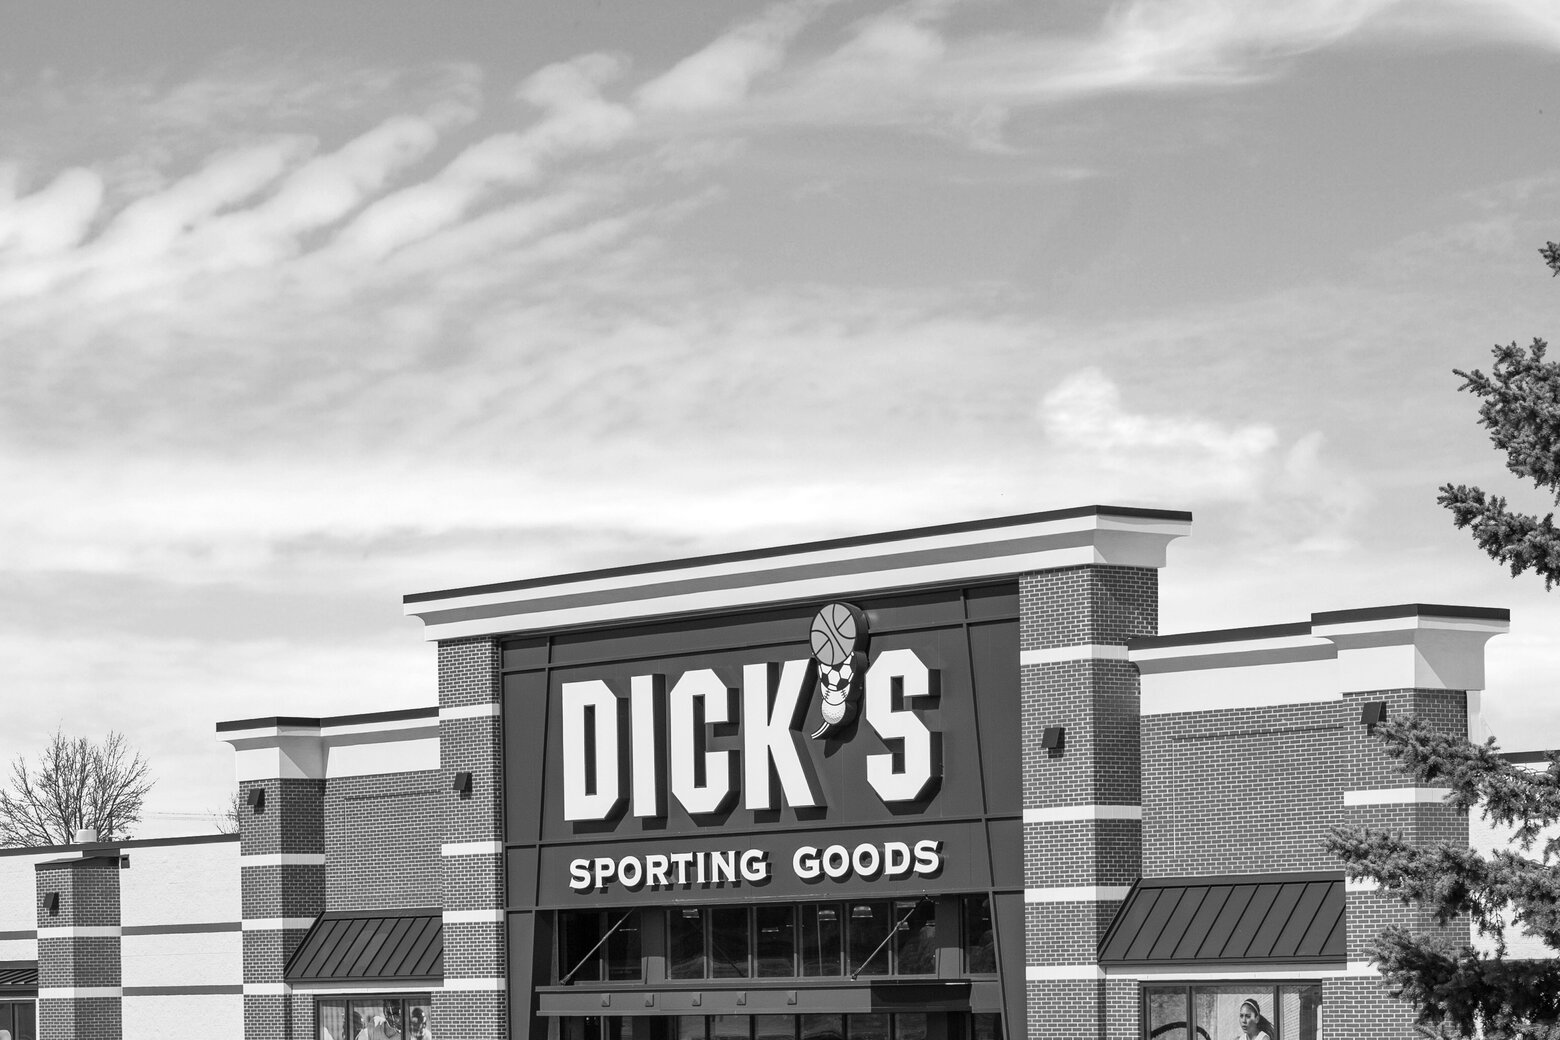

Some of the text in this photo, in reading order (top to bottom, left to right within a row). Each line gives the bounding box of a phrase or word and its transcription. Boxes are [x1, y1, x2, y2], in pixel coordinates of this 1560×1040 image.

[562, 605, 931, 821] DICK'S
[569, 839, 940, 890] SPORTING GOODS
